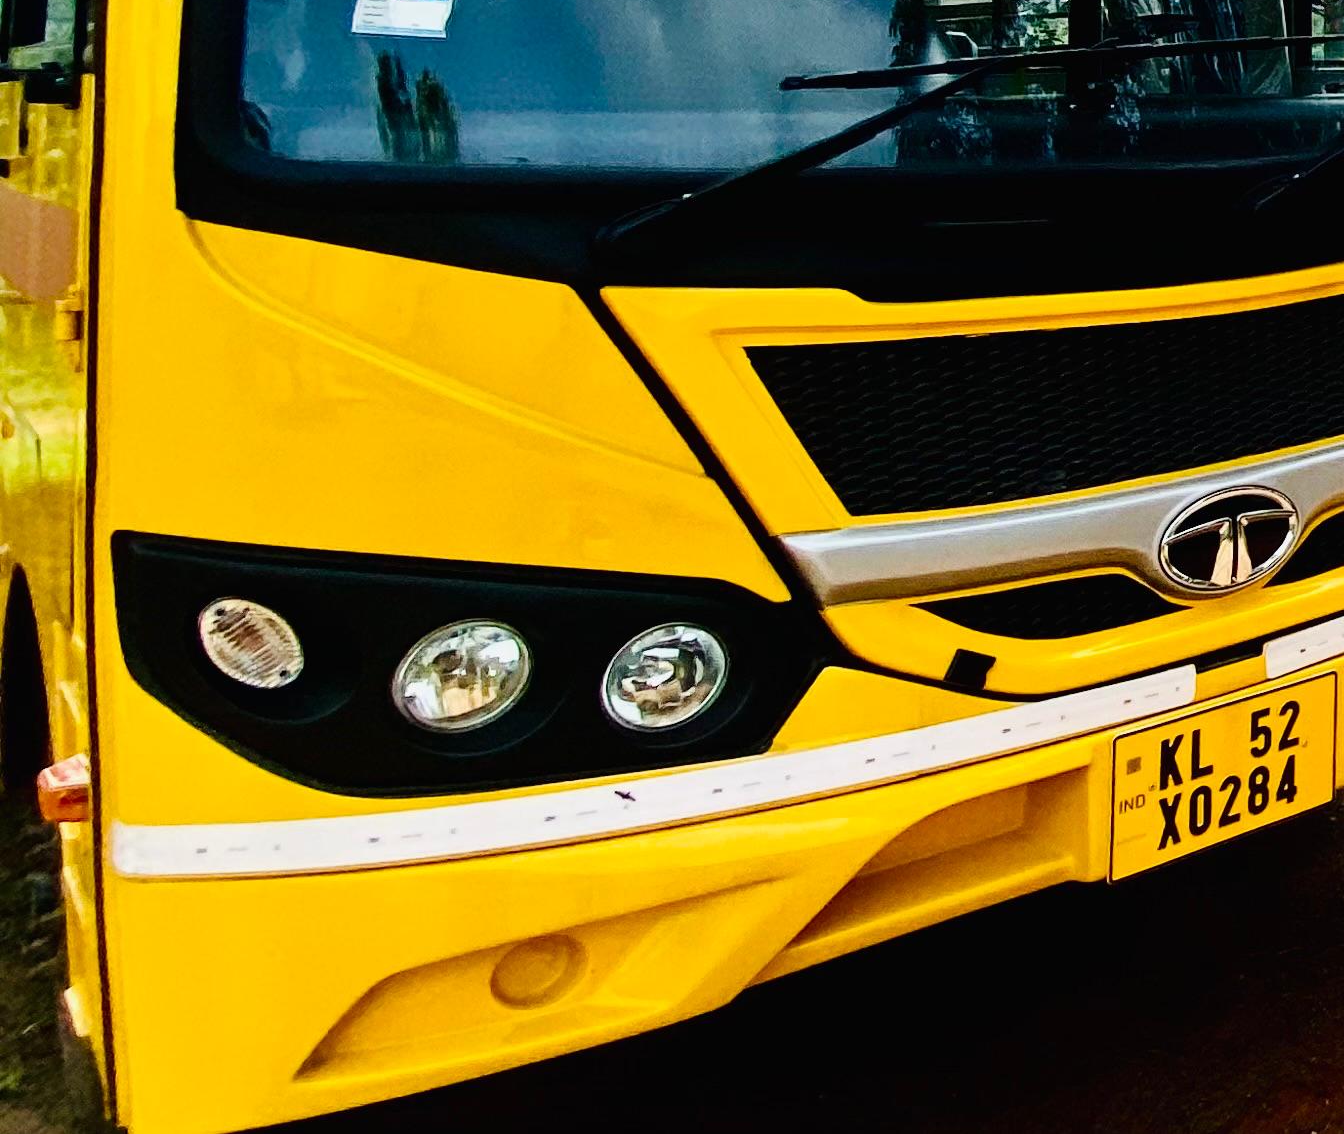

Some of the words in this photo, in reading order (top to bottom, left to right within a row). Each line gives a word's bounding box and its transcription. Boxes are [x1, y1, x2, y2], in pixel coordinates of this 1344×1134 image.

[1159, 728, 1214, 791] KL
[1249, 699, 1301, 759] 52
[1118, 793, 1146, 815] IND
[1156, 754, 1298, 851] X0284
